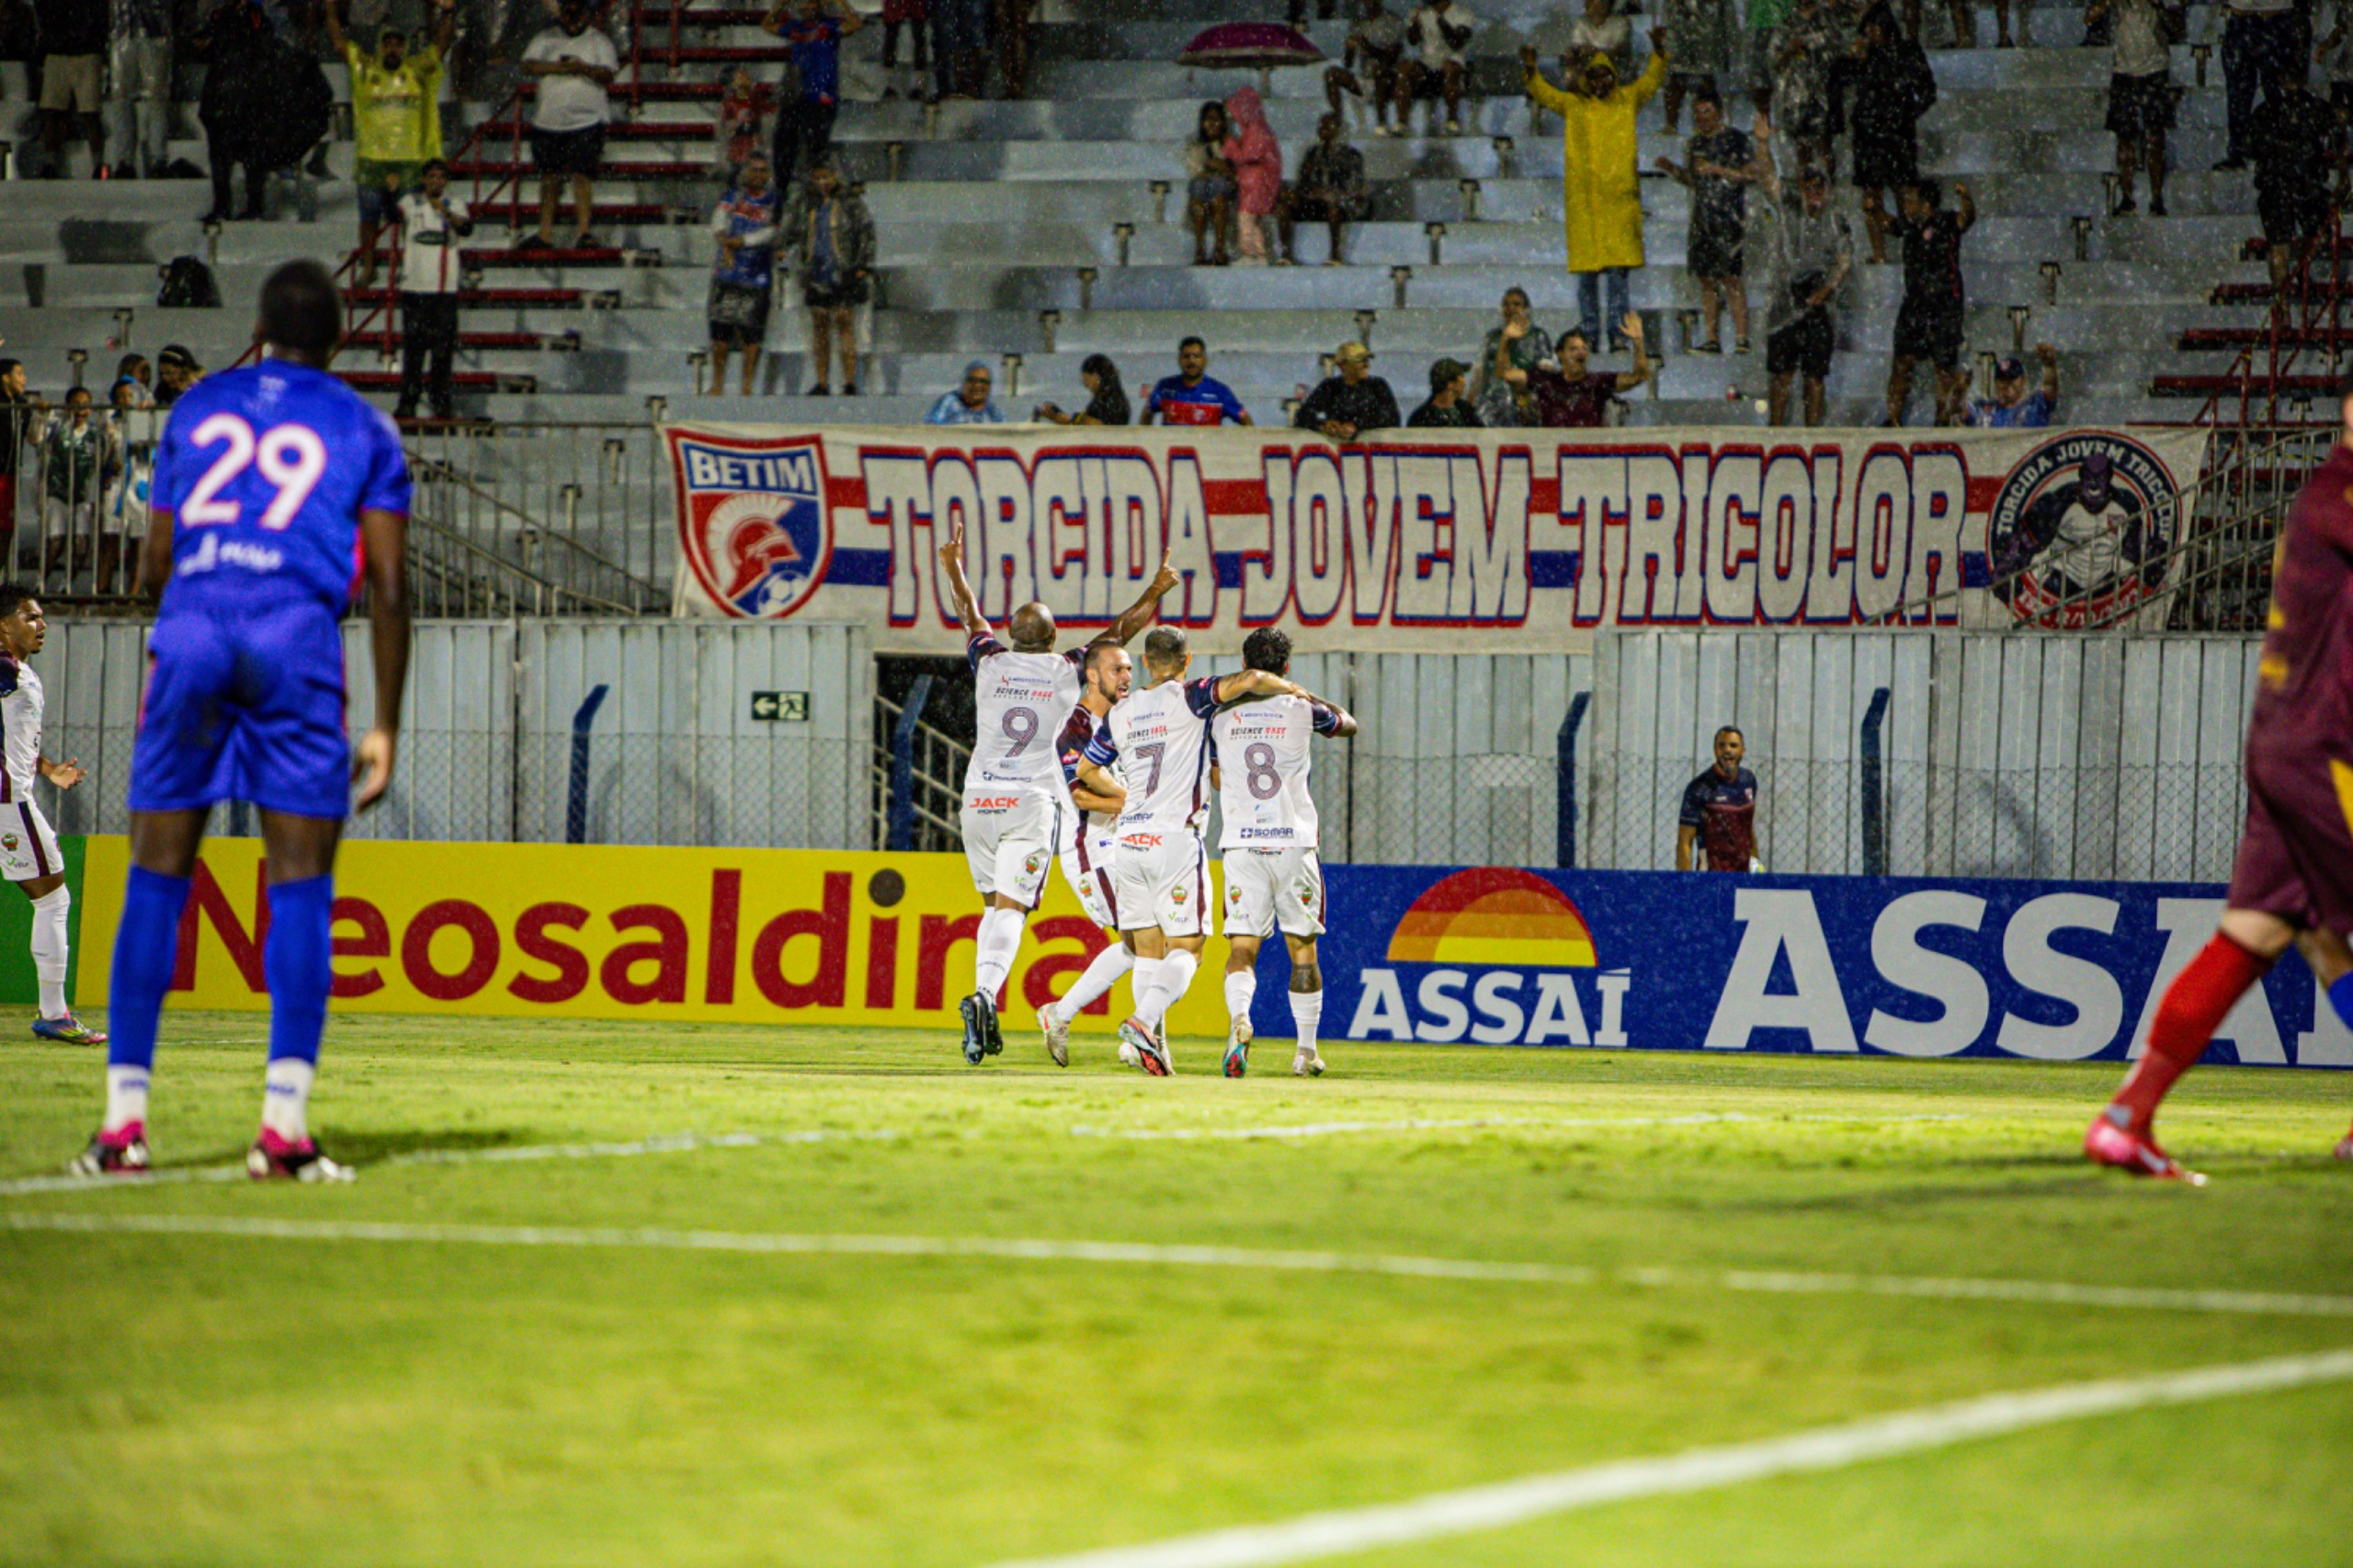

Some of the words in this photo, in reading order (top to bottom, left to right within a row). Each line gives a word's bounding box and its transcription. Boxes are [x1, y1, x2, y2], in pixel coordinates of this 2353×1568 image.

[180, 411, 328, 532] 29
[690, 449, 813, 492] BETIM
[1996, 455, 2053, 536] TORCIDA
[2055, 439, 2126, 463] JOVEM
[858, 445, 1217, 629] TORCIDA
[1239, 443, 1533, 628] JOVEM
[1557, 441, 1969, 628] TRICOLOR
[1002, 707, 1039, 757] 9
[1135, 742, 1165, 800] 7
[1245, 743, 1282, 800] 8
[969, 797, 1019, 809] JACK
[1254, 827, 1293, 836] SOMAR
[169, 857, 1113, 1017] Neosaldina
[1347, 967, 1631, 1047] ASSAÍ
